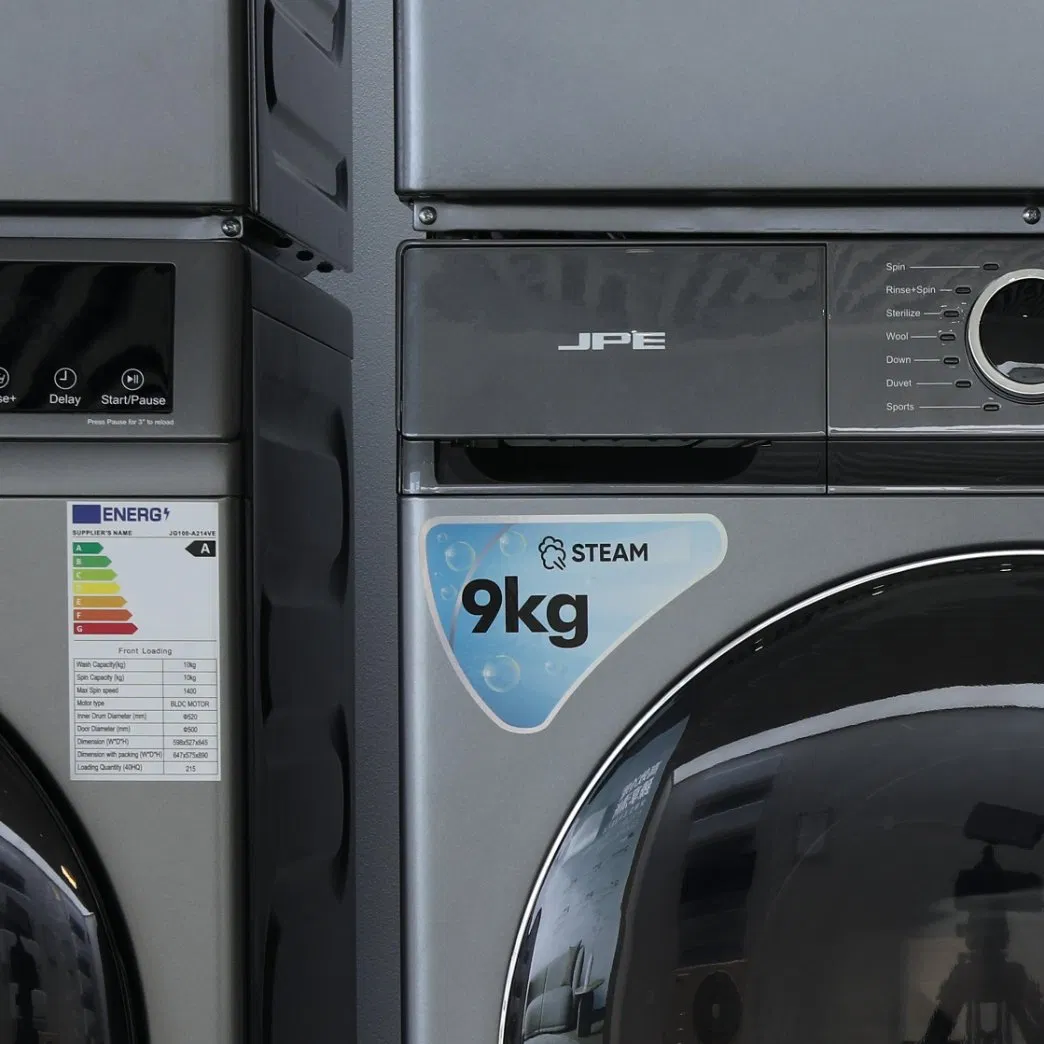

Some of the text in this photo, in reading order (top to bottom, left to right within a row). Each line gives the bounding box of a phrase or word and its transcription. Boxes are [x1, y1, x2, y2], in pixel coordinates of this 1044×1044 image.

[886, 263, 905, 271] Spin
[886, 286, 936, 295] Rinse+Spin
[886, 309, 920, 317] Sterilize
[557, 330, 666, 351] JPE
[886, 332, 908, 340] Wool
[886, 356, 911, 364] Down
[886, 379, 912, 387] Duvet
[49, 394, 81, 406] Delay
[101, 395, 166, 405] Start/Pause
[886, 403, 914, 412] Sports
[103, 508, 161, 521] ENERG
[200, 543, 210, 553] A
[572, 543, 648, 563] STEAM
[462, 576, 589, 649] 9kg
[119, 751, 138, 759] packing
